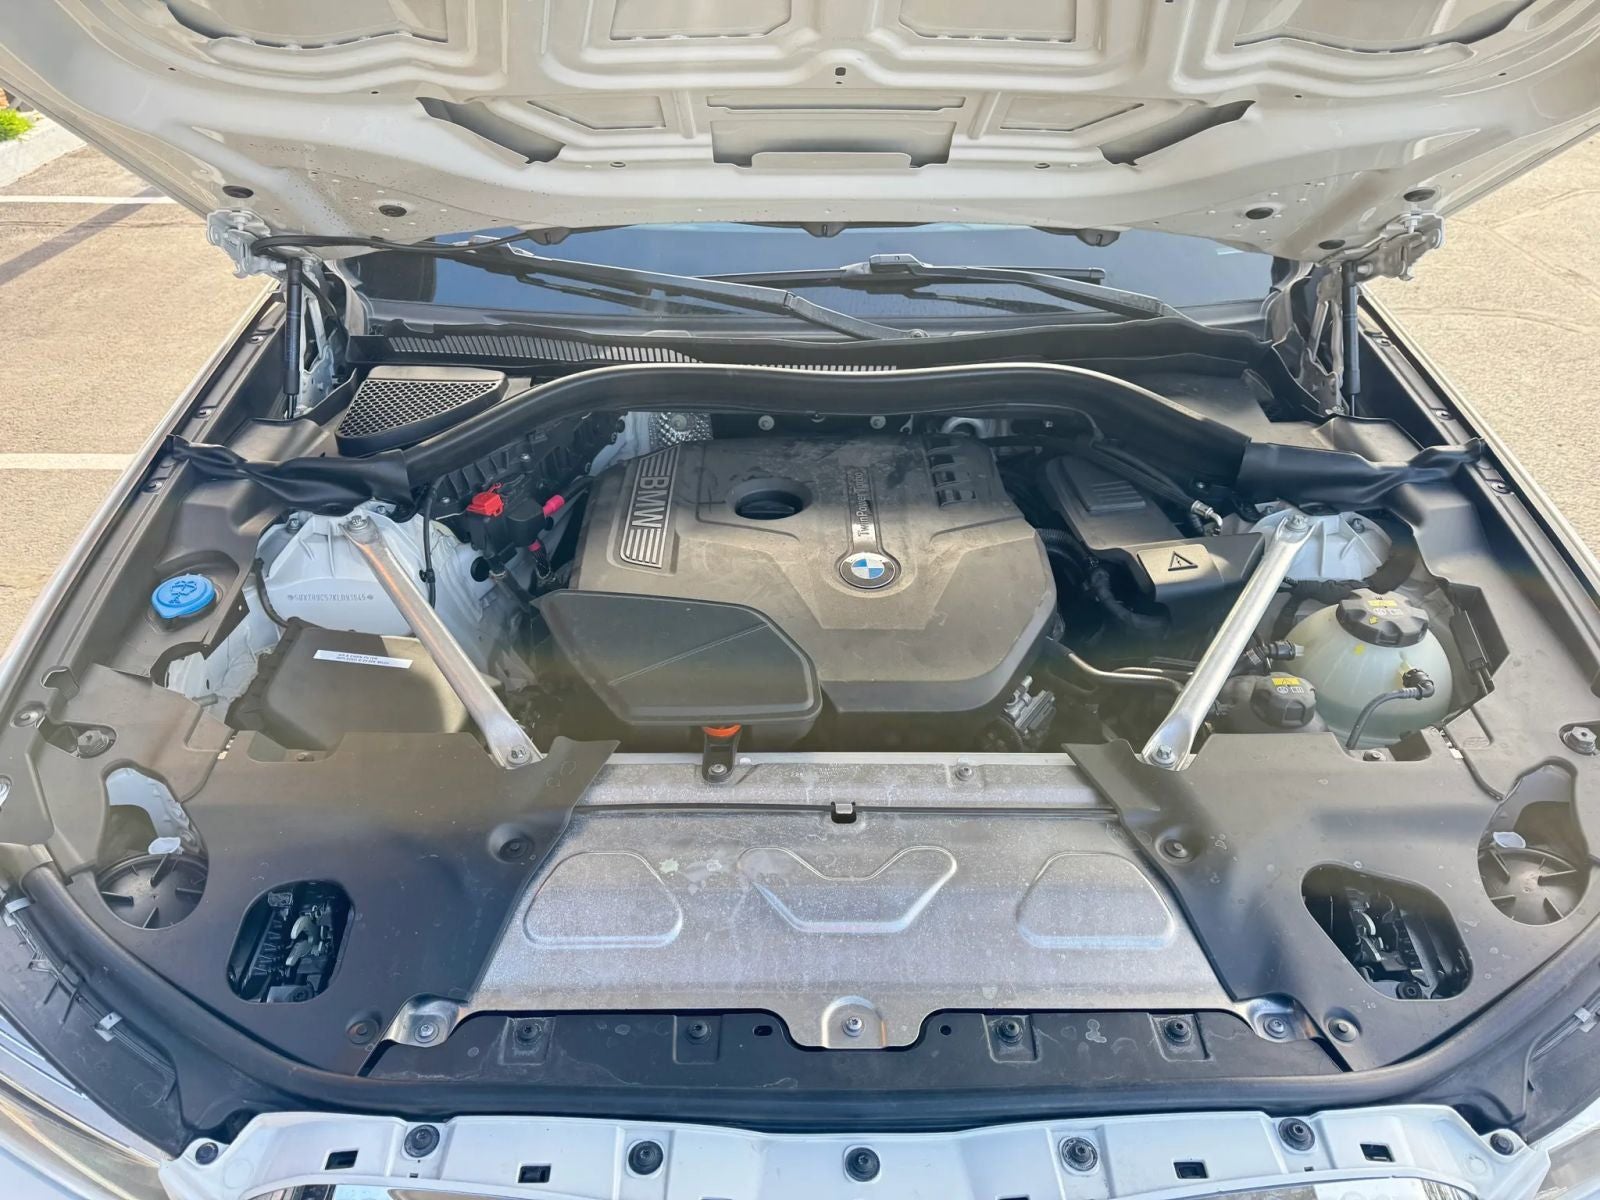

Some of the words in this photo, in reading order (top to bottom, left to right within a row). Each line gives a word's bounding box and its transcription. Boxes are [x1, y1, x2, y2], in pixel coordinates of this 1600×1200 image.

[631, 476, 669, 528] BMW
[853, 472, 866, 493] Turbo
[856, 494, 870, 537] TwinPower
